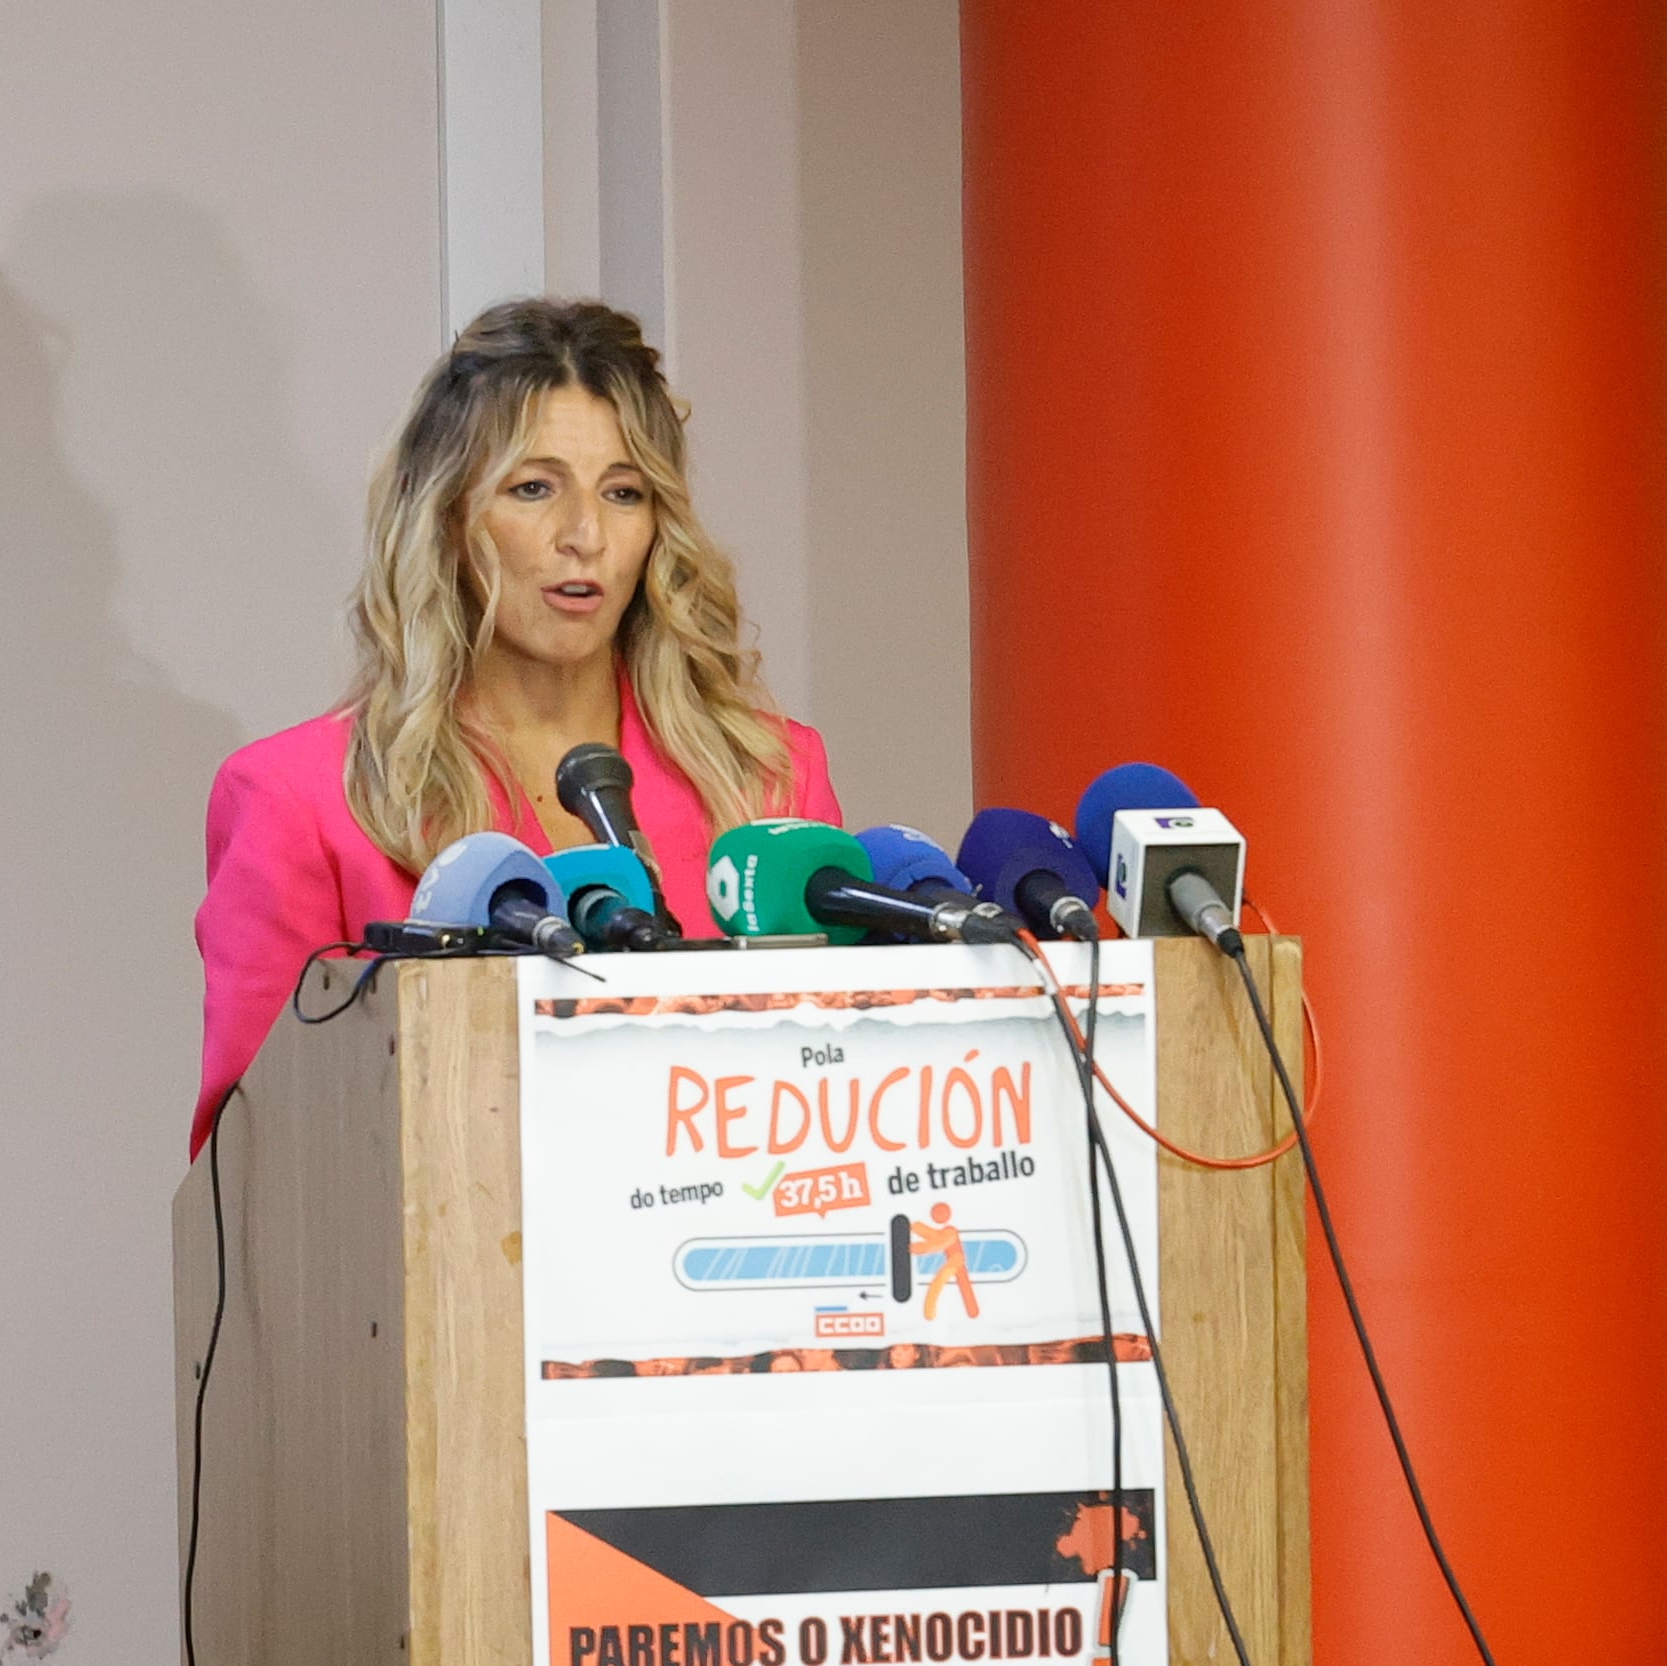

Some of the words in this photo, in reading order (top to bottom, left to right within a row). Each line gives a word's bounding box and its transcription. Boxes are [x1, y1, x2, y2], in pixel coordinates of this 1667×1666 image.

[800, 1043, 845, 1068] Pola
[665, 1048, 1032, 1159] REDUCIÓN
[630, 1188, 655, 1210] do
[659, 1181, 724, 1205] tempo
[887, 1166, 920, 1195] de
[927, 1149, 1036, 1190] traballo
[817, 1315, 882, 1335] CCOO
